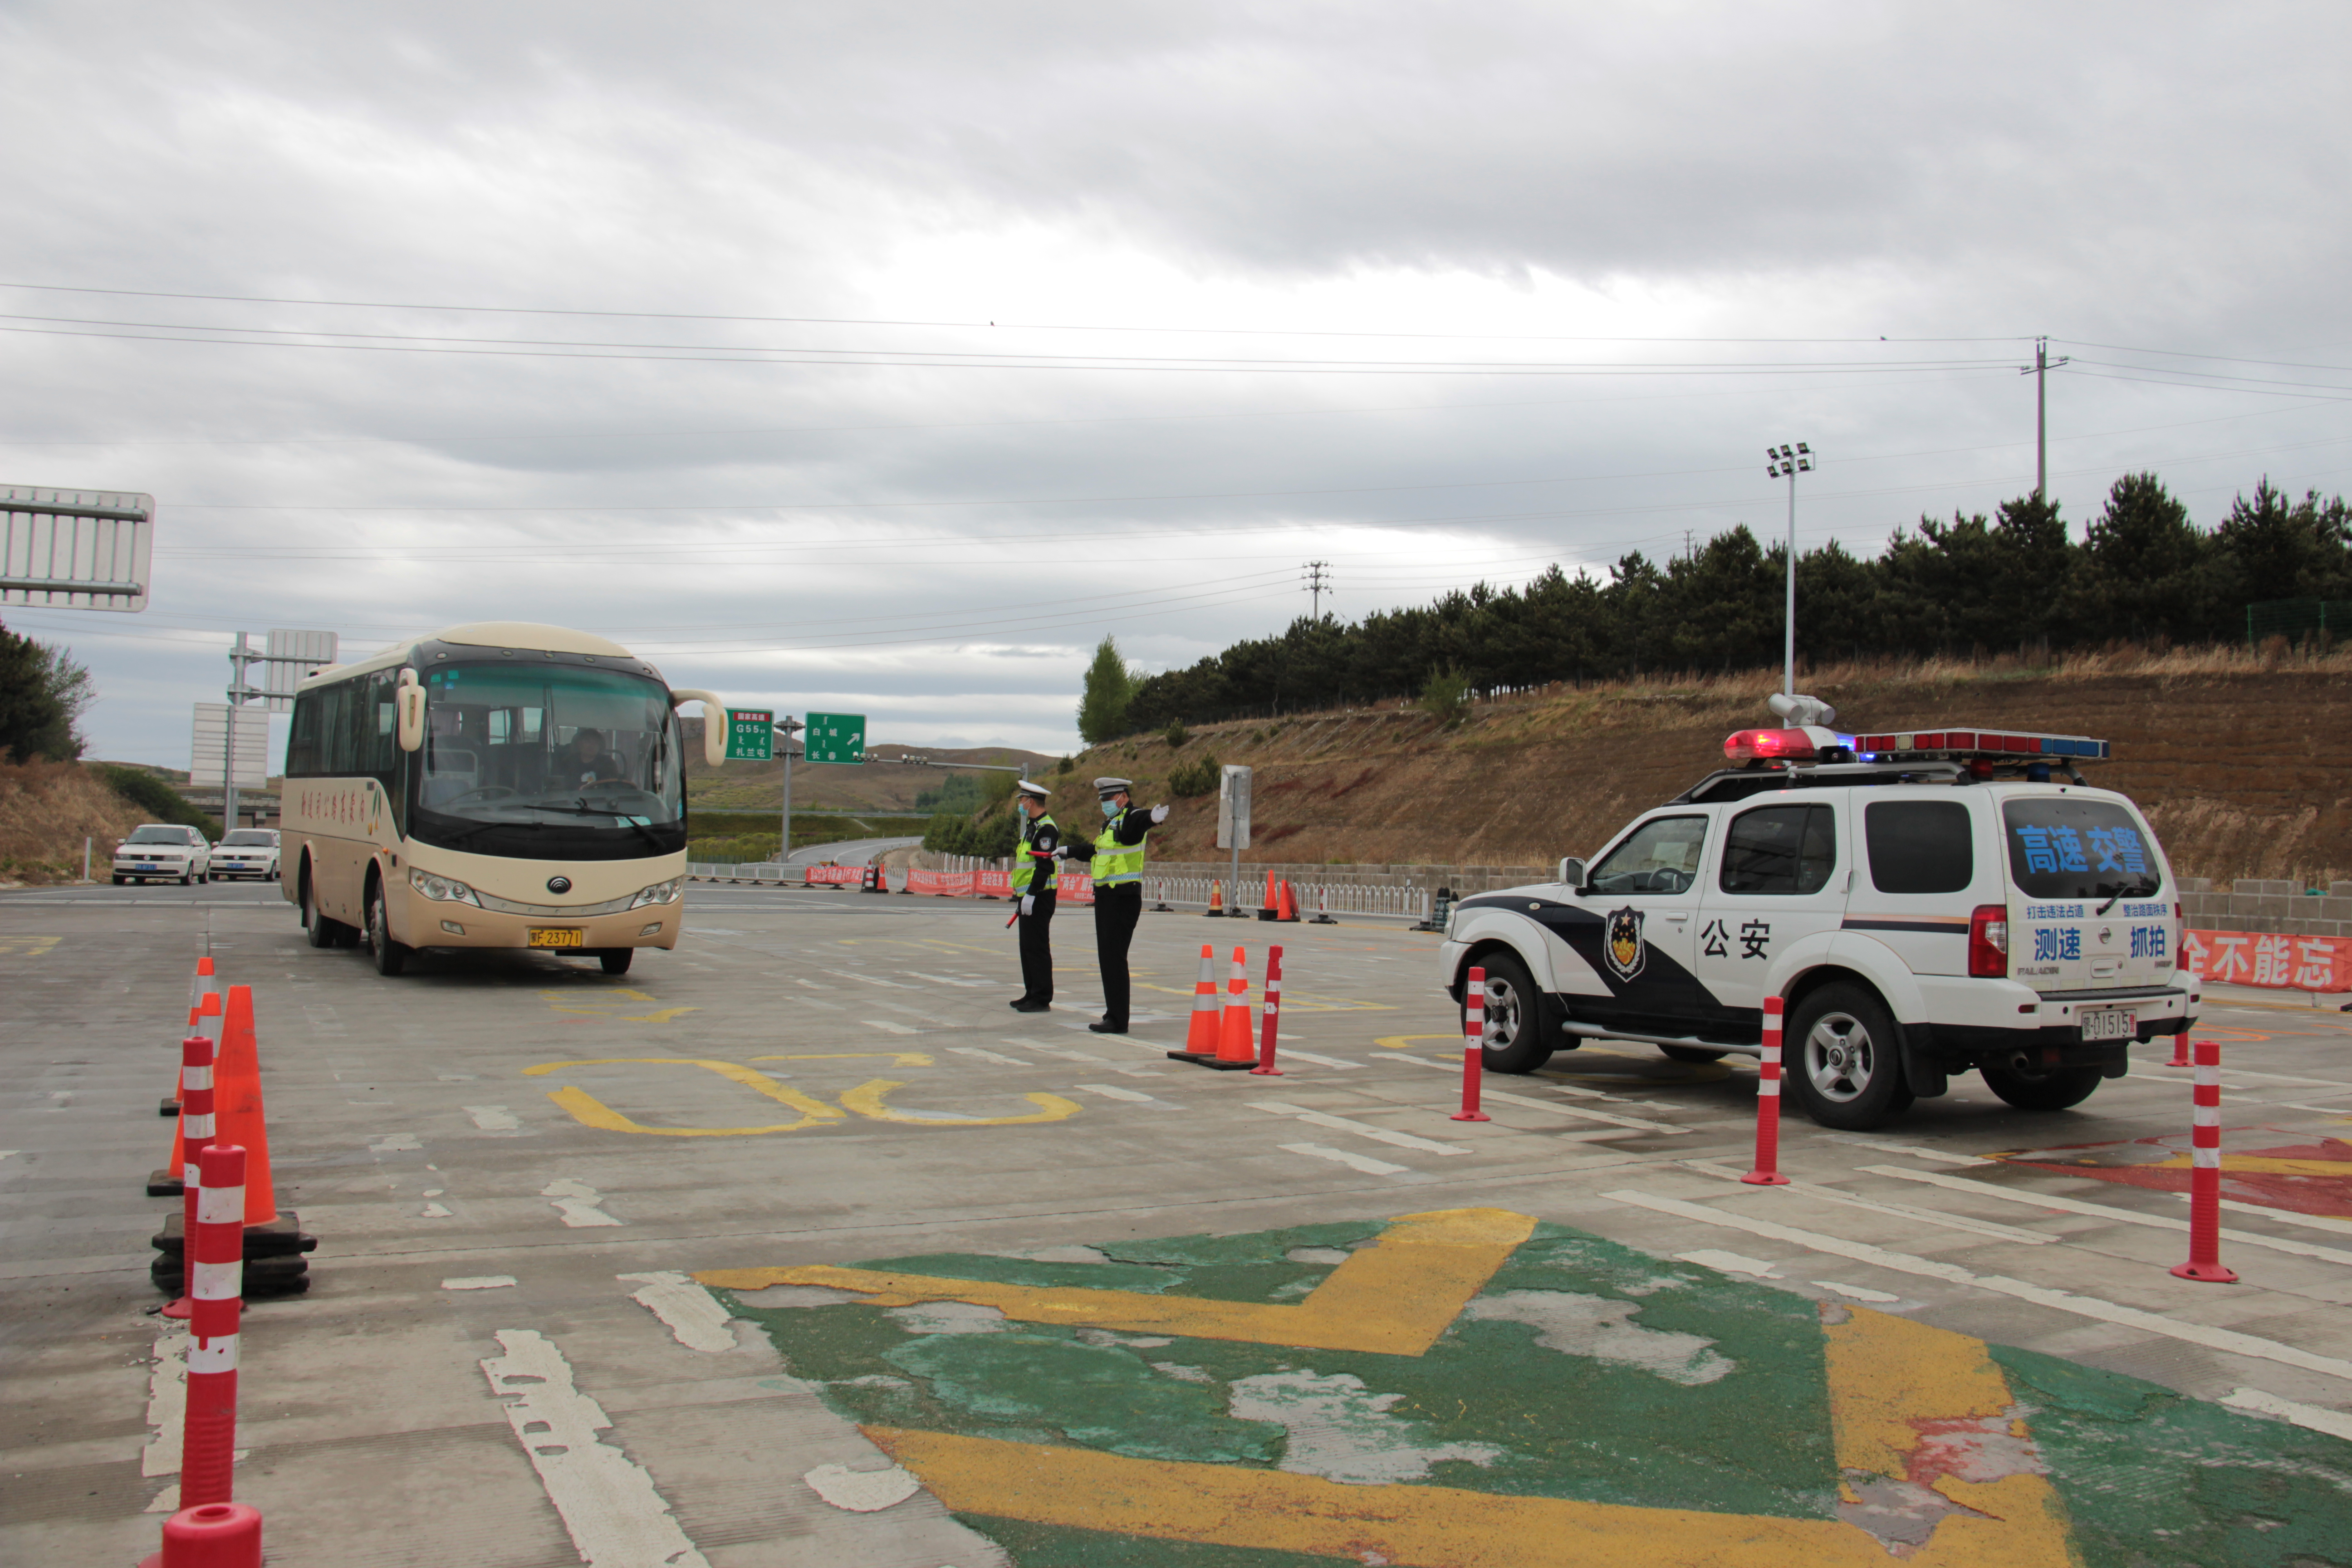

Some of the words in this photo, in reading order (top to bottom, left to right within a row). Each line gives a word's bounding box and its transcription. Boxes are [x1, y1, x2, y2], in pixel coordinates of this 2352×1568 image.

[738, 713, 765, 721] 国家高速
[813, 728, 838, 737] 白城
[736, 748, 765, 758] 扎兰屯
[812, 751, 836, 760] 长春
[2016, 825, 2146, 874] 高速交警
[981, 872, 1004, 887] 安全在身
[2027, 905, 2084, 919] 打击违法占道
[2123, 904, 2167, 917] 整治路面秩序
[1700, 918, 1770, 960] 公安
[2034, 927, 2081, 961] 测速
[2131, 925, 2165, 958] 抓拍
[2018, 966, 2059, 975] PALADIN
